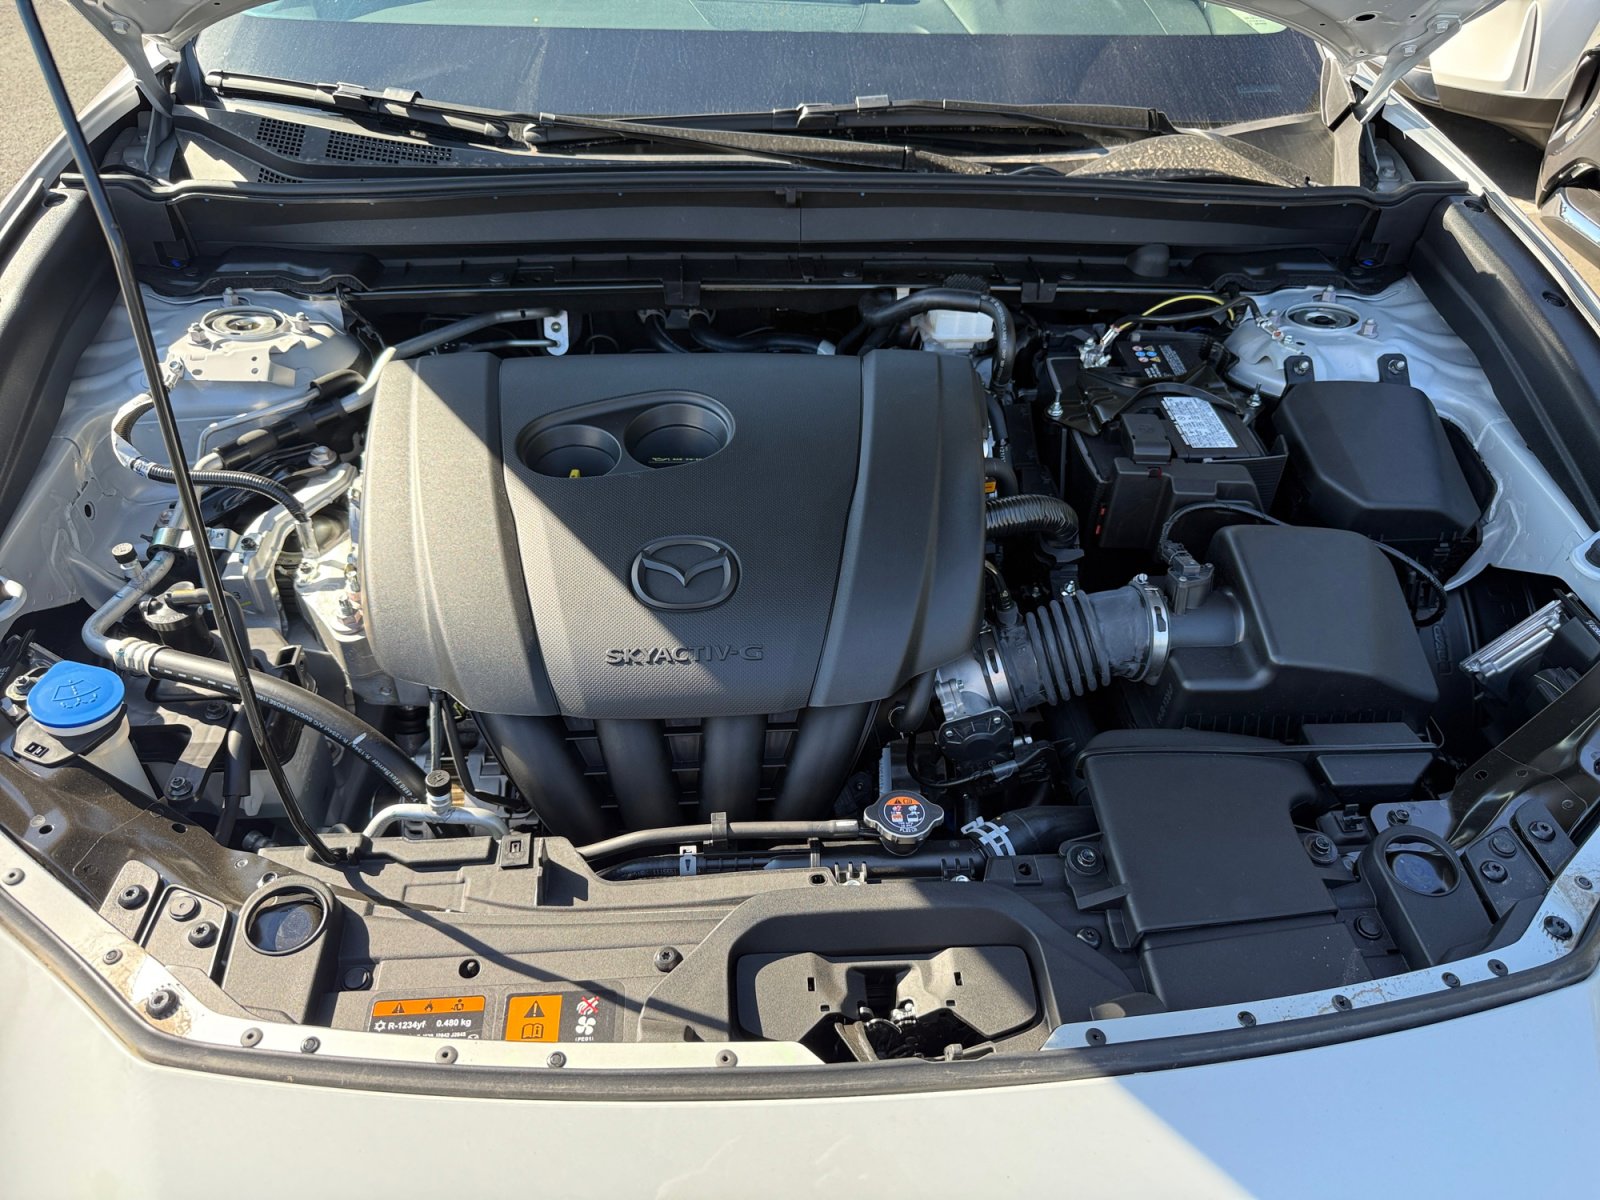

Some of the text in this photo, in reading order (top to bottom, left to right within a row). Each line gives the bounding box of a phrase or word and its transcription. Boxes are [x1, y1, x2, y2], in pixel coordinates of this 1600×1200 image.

[606, 644, 763, 664] SKYACTIV-G
[269, 698, 287, 709] HOSE
[286, 704, 313, 723] SUCTION
[387, 1018, 471, 1030] R-1234yf 0.480 kg
